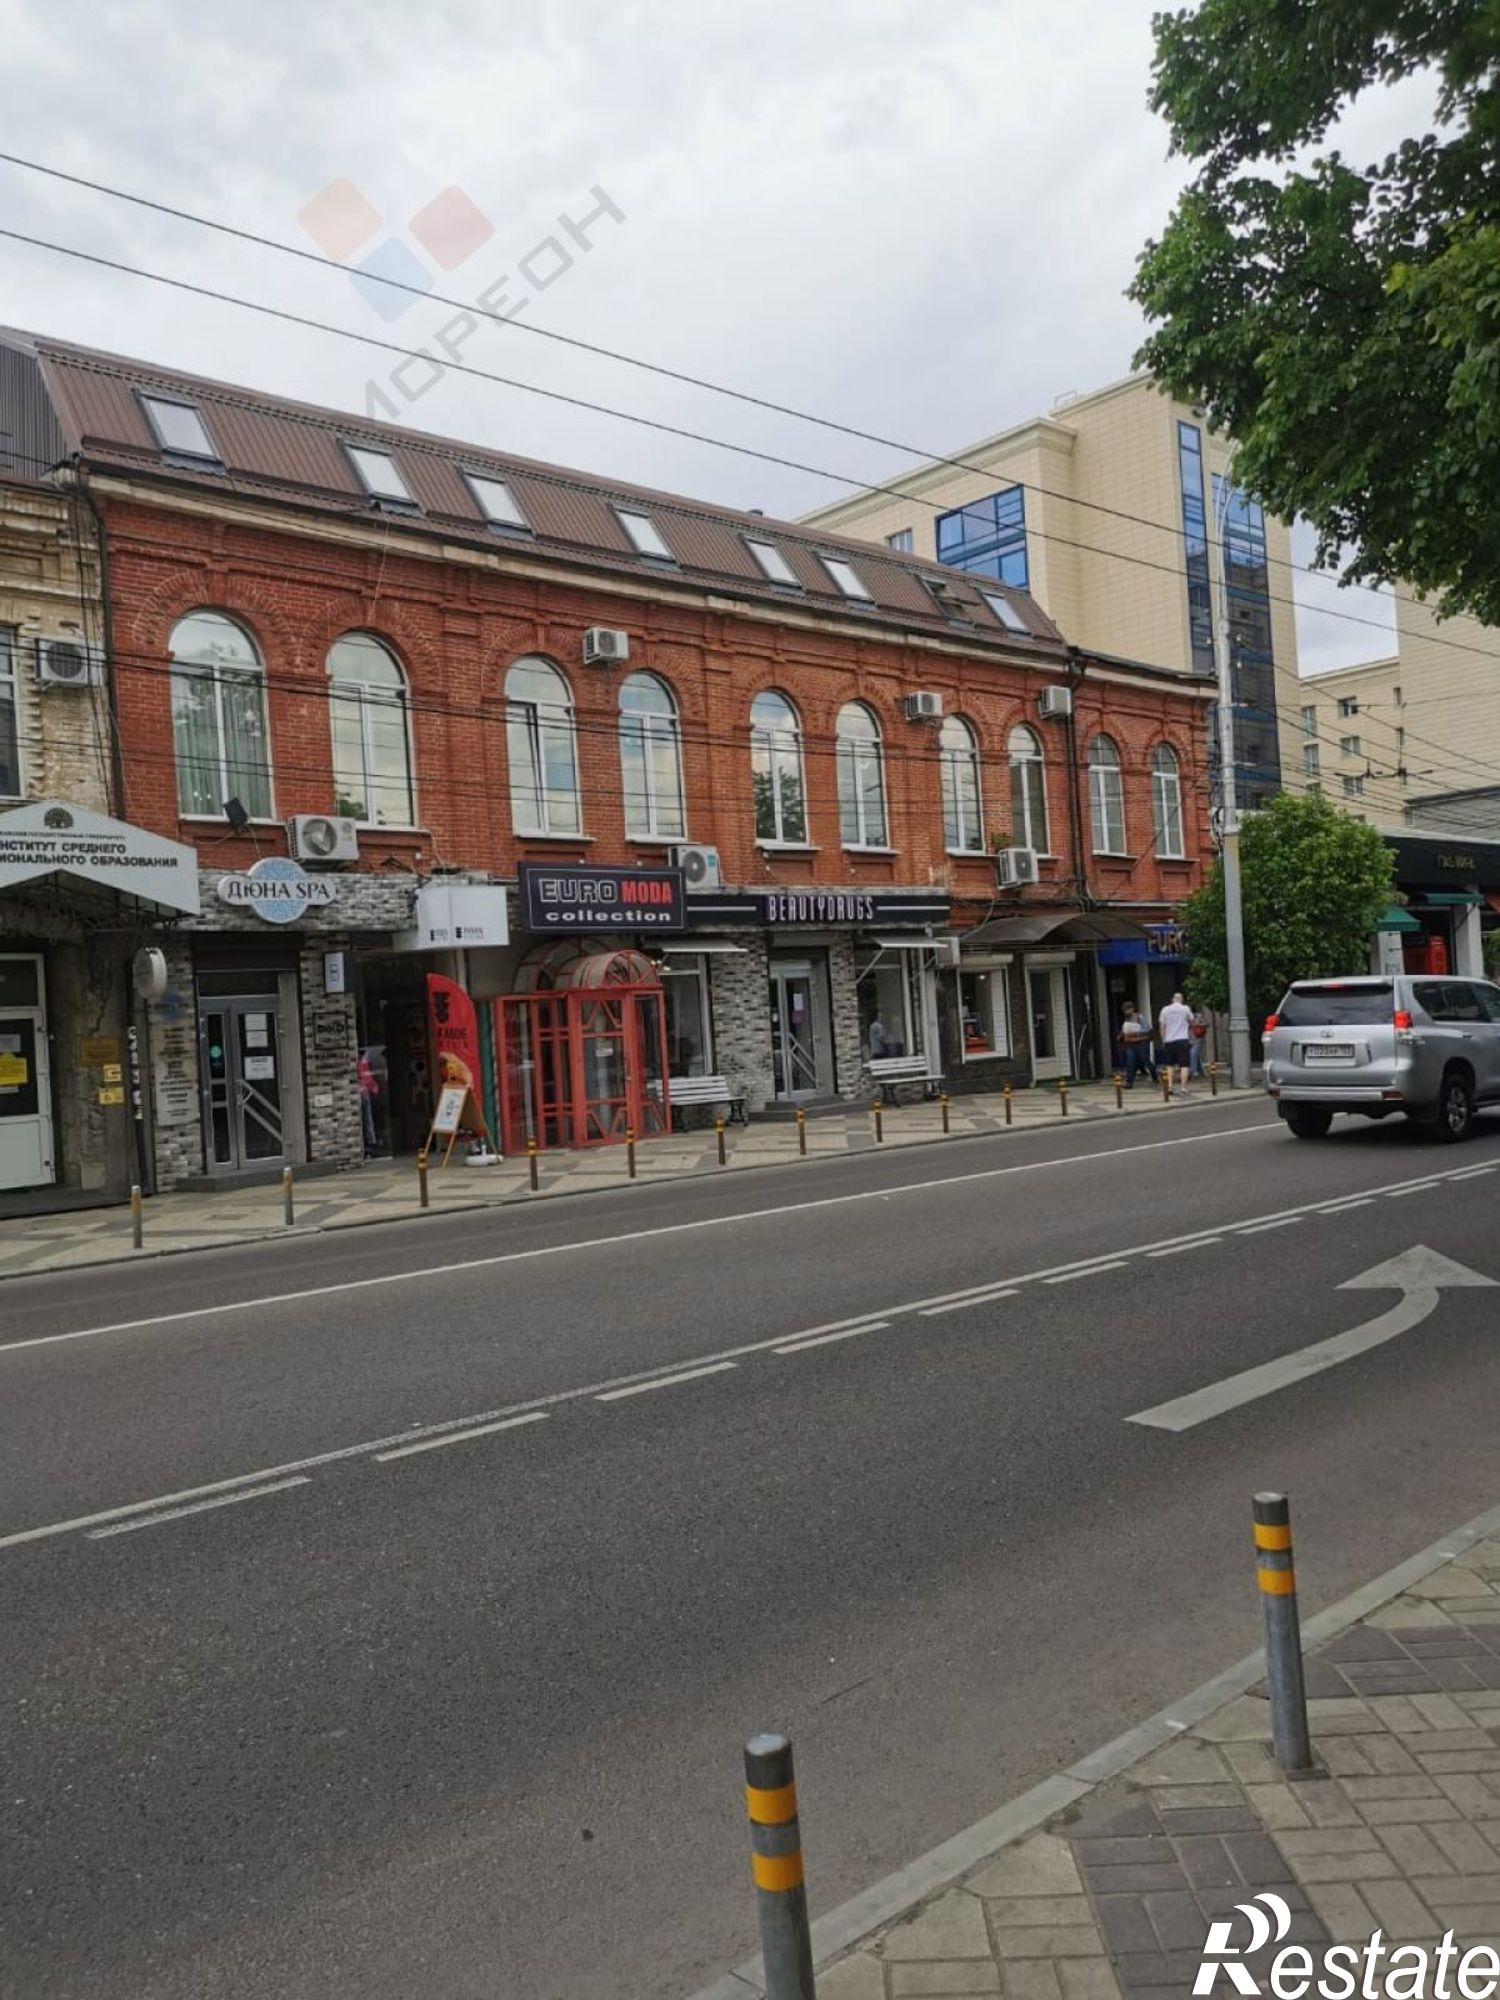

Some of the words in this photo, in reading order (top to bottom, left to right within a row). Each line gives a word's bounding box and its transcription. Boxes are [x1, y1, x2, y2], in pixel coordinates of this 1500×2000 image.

[0, 841, 56, 851] НСТИТУТ
[62, 842, 126, 853] СРЕДНЕГО
[0, 853, 86, 864] ИОНАЛЬНОГО
[90, 855, 178, 867] ОБРАЗОВАНИЯ
[227, 881, 290, 899] ДЮНА
[295, 882, 330, 899] SPA
[538, 878, 617, 903] EURO
[620, 880, 673, 904] MODA
[545, 910, 672, 922] collection
[768, 895, 874, 921] BEAUTYDRUGS
